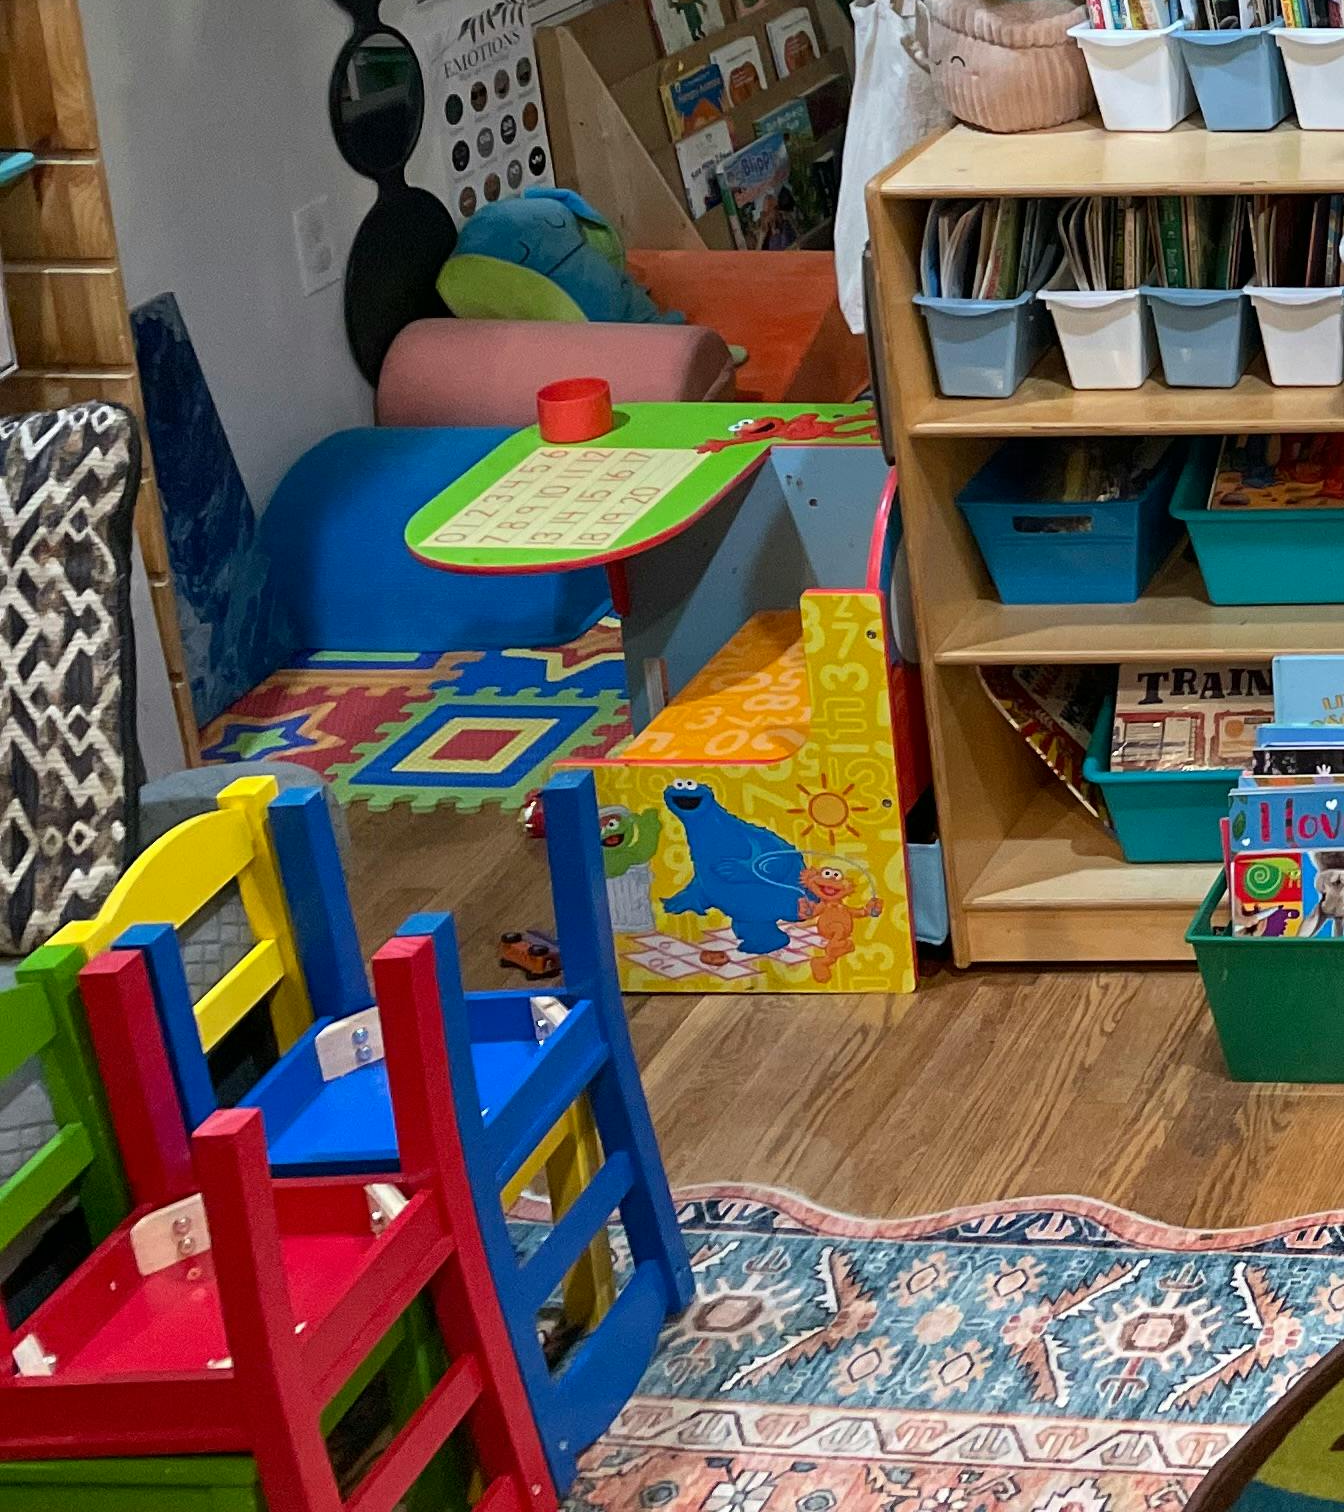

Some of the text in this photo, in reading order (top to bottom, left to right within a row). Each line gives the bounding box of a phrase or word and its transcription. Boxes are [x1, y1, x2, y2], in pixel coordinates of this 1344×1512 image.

[444, 31, 521, 79] EMOTIONS
[533, 485, 570, 498] 10
[619, 487, 661, 505] 20
[1260, 802, 1270, 841] I
